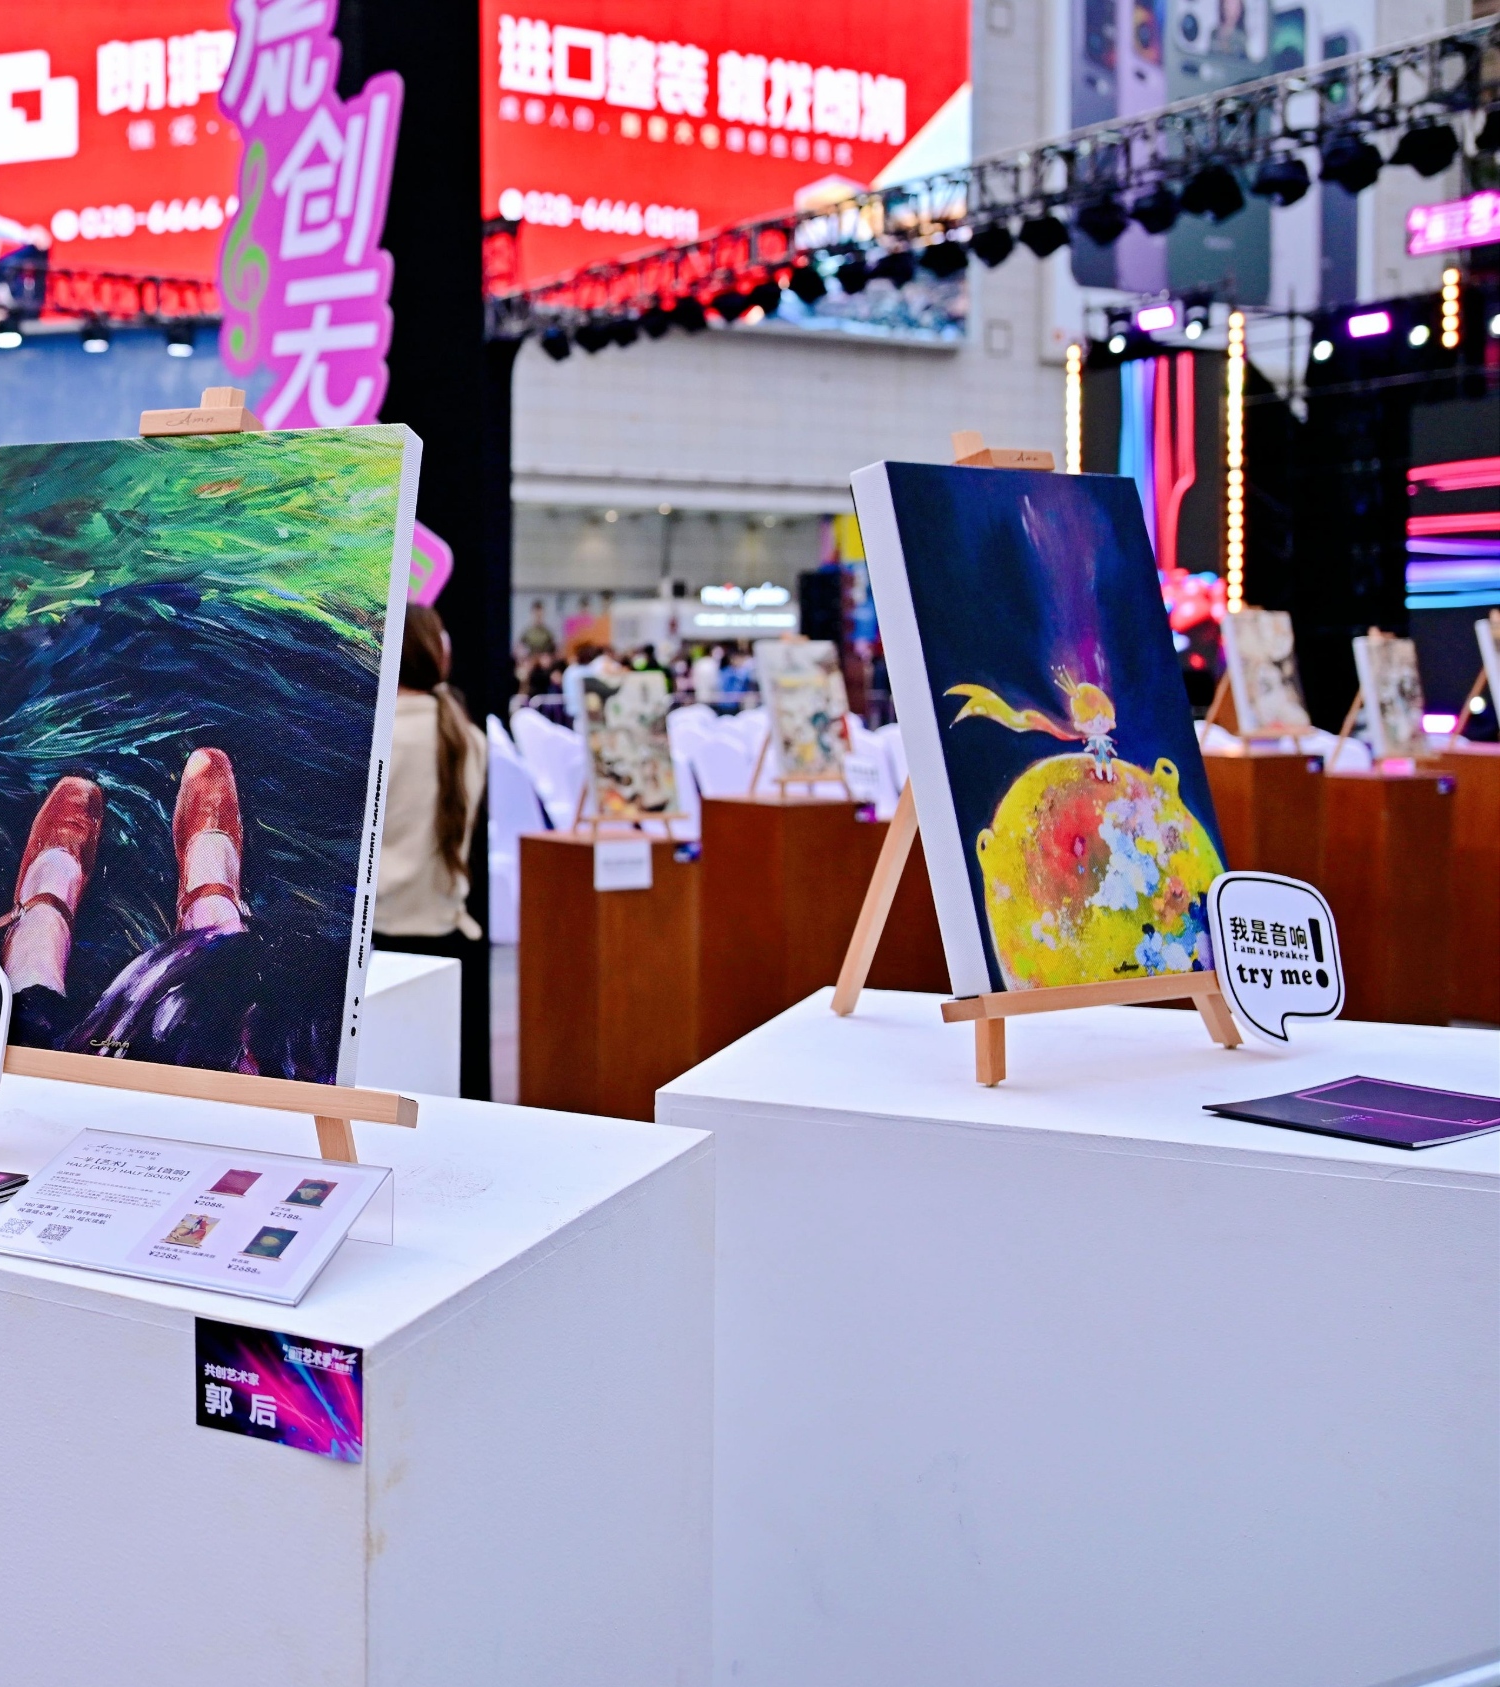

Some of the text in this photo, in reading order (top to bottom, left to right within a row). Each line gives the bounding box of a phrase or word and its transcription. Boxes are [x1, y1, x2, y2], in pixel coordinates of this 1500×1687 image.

[498, 13, 709, 117] 进口整装
[1230, 917, 1308, 950] 我是音响
[1233, 941, 1237, 952] I
[1240, 945, 1256, 955] am
[1268, 949, 1309, 961] speaker
[1236, 963, 1313, 989] try me
[204, 1362, 260, 1387] 共创艺术家
